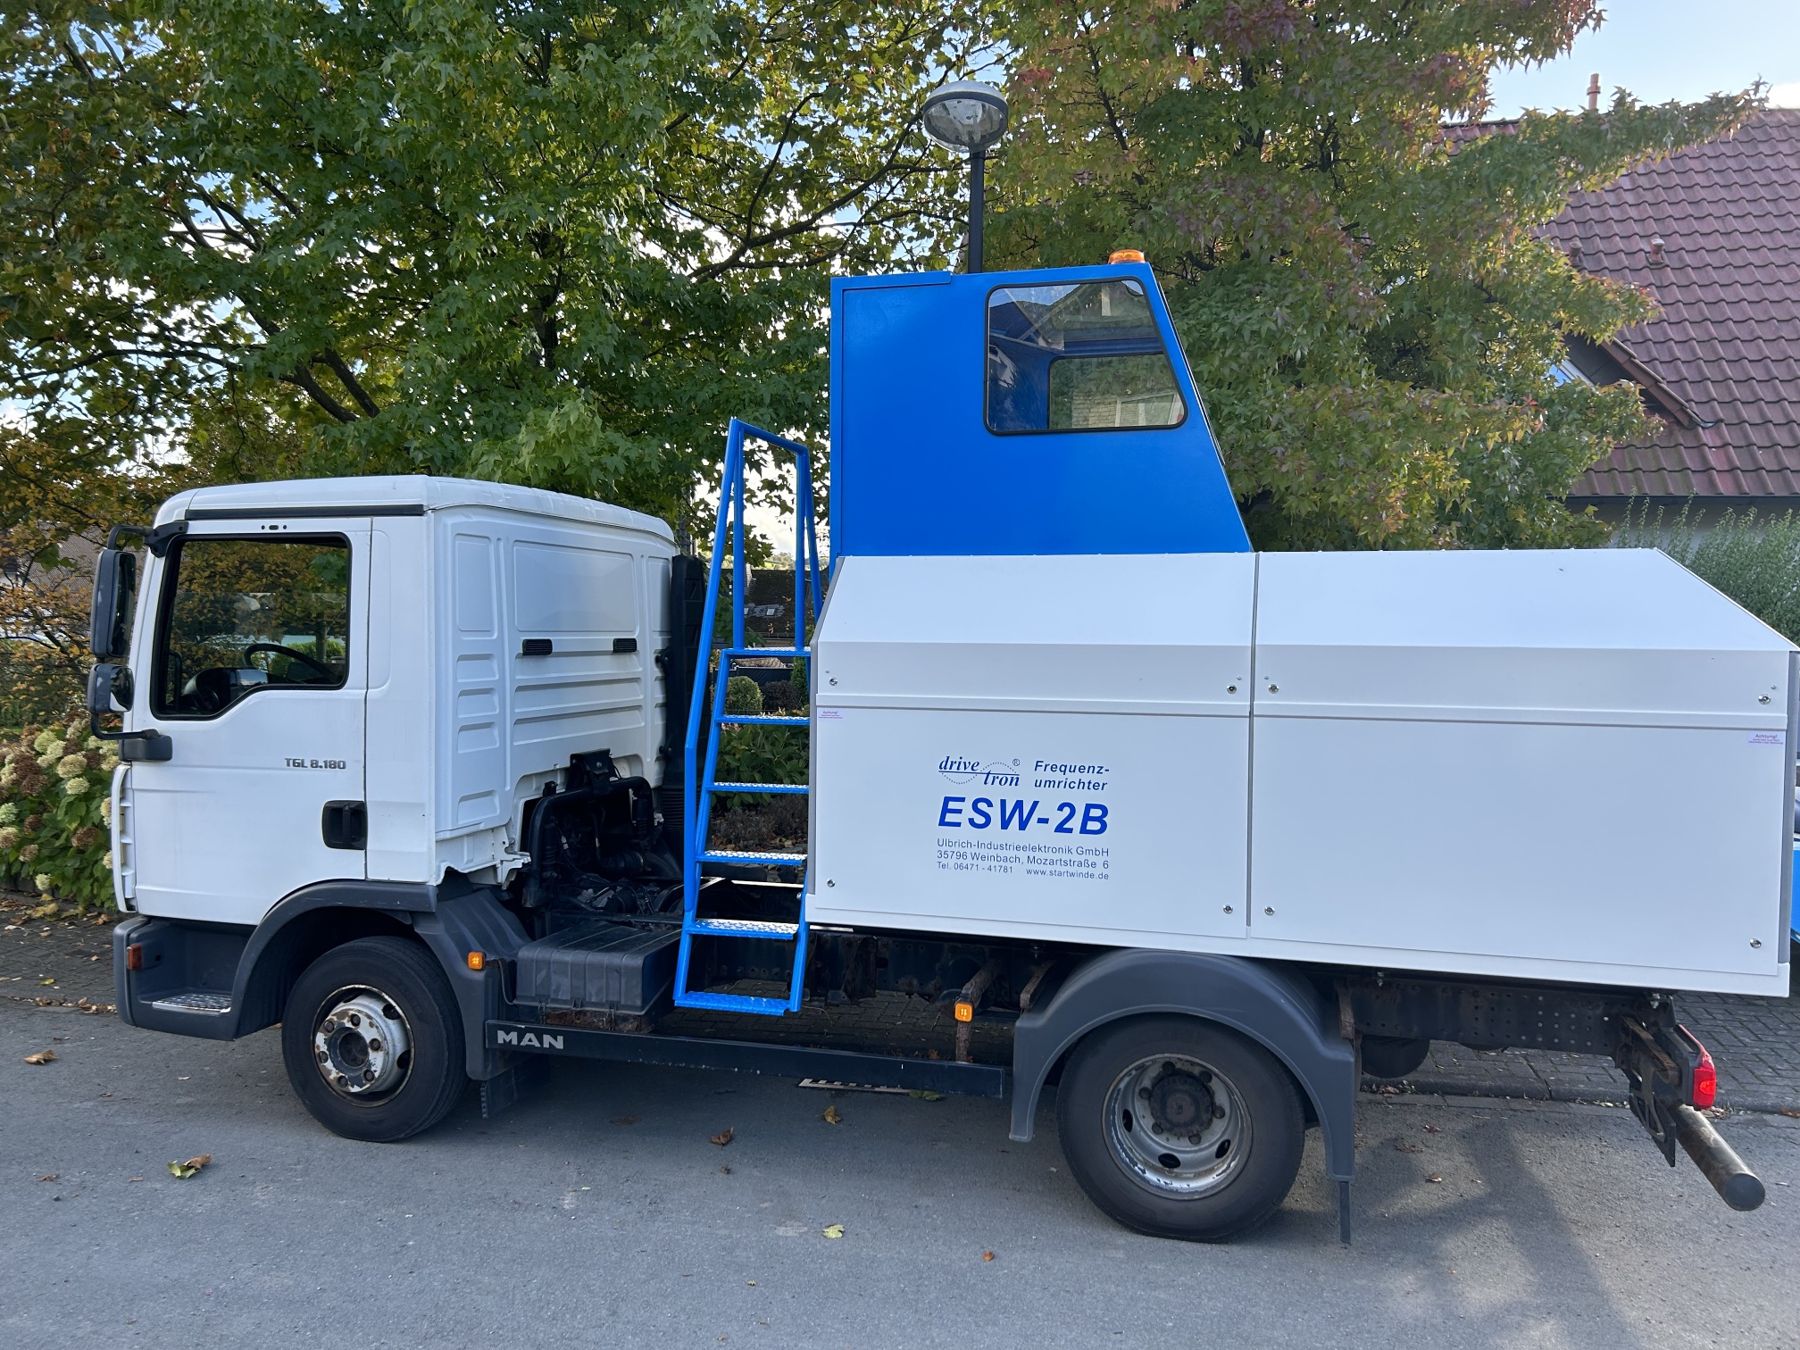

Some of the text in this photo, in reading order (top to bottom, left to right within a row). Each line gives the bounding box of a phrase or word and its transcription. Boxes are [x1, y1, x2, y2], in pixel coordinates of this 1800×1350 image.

[284, 758, 346, 770] TGL 8.180
[938, 755, 980, 772] drive
[1034, 760, 1110, 776] Frequenz-
[983, 770, 1020, 787] tron
[1034, 778, 1108, 791] umrichter
[938, 796, 1109, 835] ESW-2B
[937, 838, 1109, 857] Ulbrich-Industrieelektronik GmbH
[937, 850, 1109, 870] 35796 Weinbach, Mozartstraße 6
[937, 861, 952, 870] Tel.
[1026, 868, 1109, 880] www.startwinde.de
[497, 1030, 564, 1049] MAN
